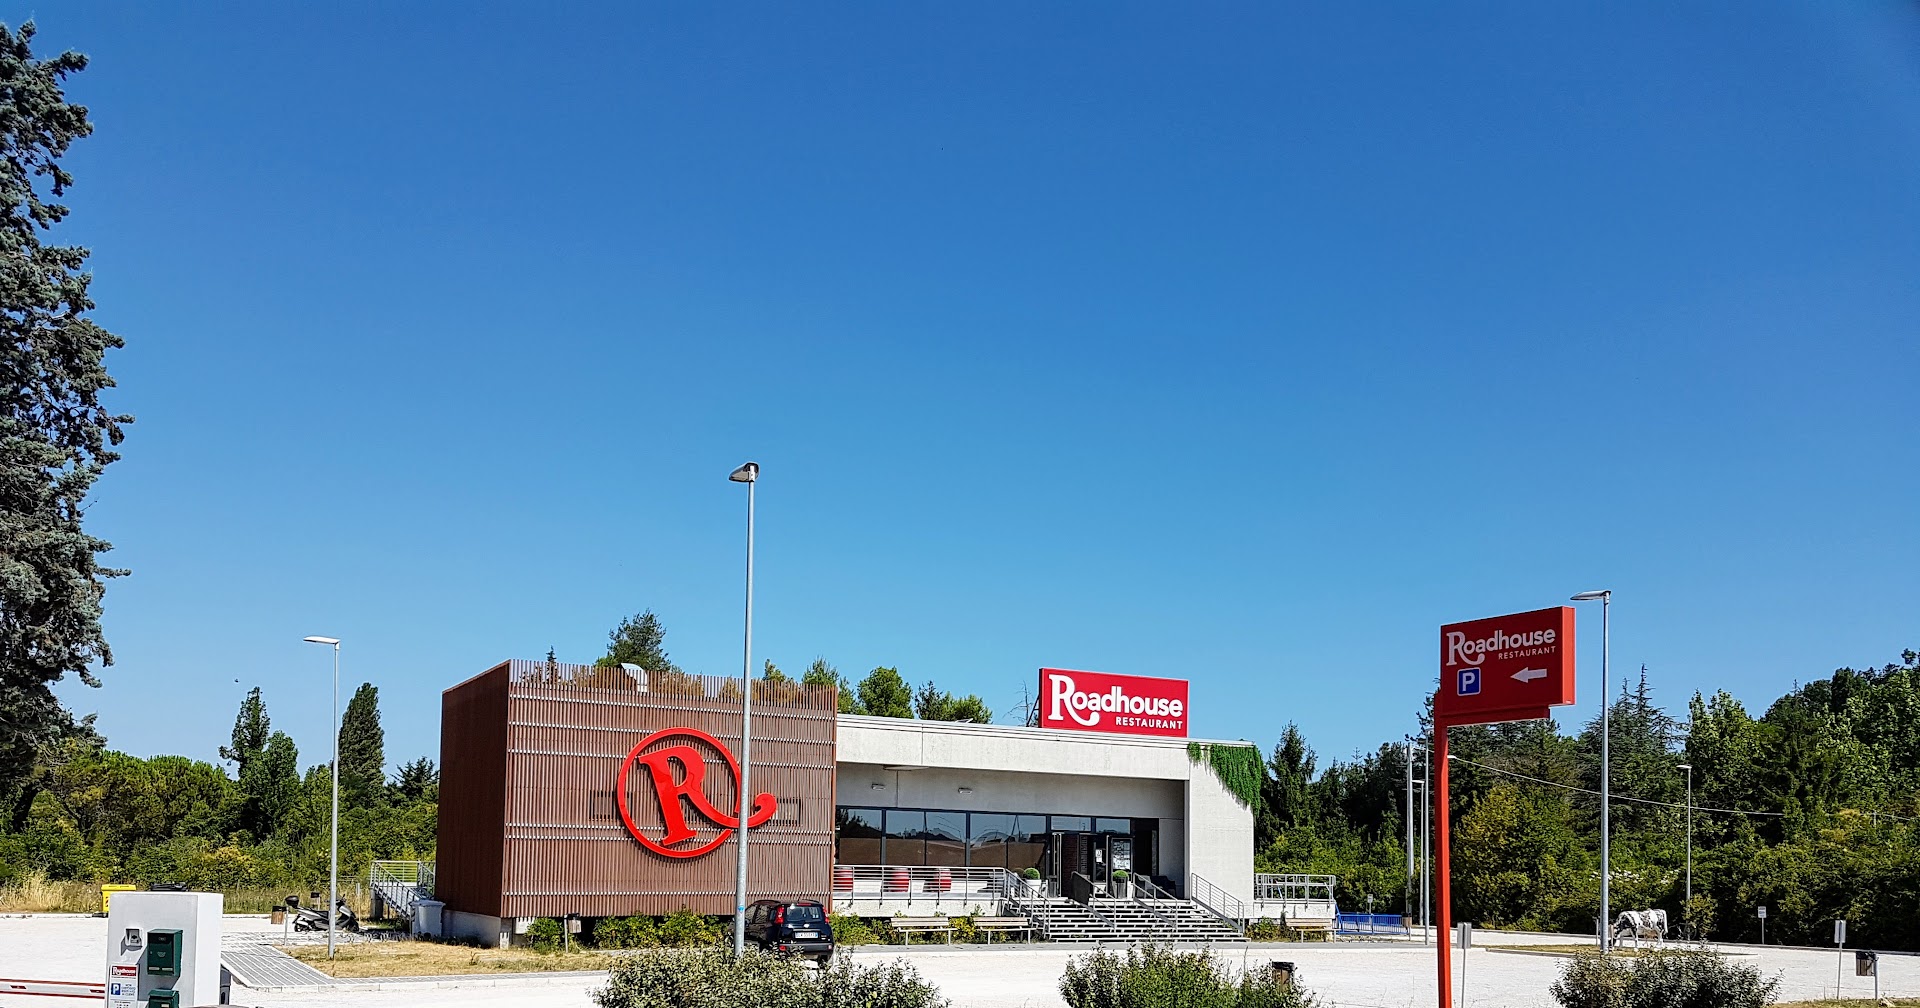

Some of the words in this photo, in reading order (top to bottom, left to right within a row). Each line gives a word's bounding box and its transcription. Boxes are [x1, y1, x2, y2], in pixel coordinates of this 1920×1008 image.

[1446, 629, 1556, 666] Roadhouse
[1498, 645, 1556, 660] RESTAURANT
[1462, 671, 1476, 691] P
[1048, 674, 1184, 726] Roadhouse
[1115, 716, 1183, 730] RESTAURANT
[638, 745, 777, 846] R
